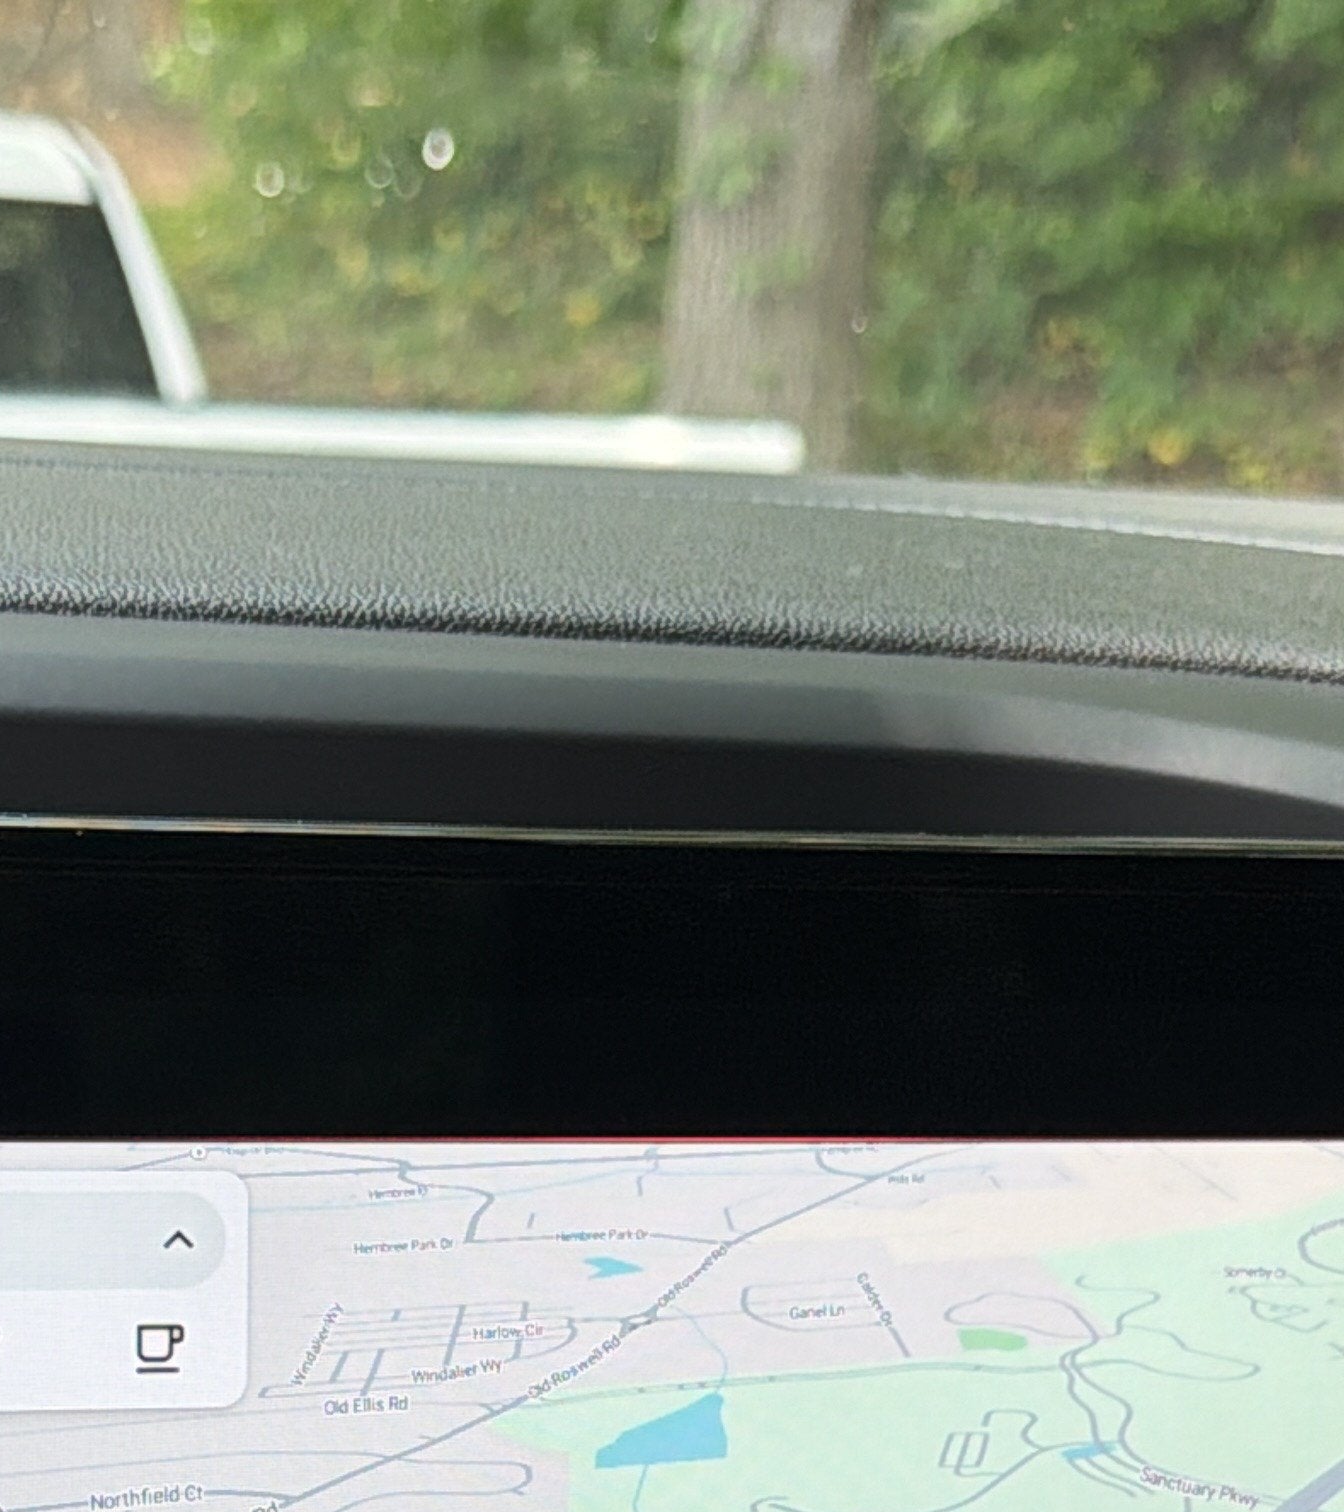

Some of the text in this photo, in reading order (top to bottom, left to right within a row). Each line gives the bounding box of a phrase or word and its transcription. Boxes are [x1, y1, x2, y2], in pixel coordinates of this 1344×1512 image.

[353, 1242, 408, 1254] Hembree
[411, 1239, 437, 1251] Park
[472, 1326, 522, 1340] Harlow
[551, 1347, 603, 1383] Roswell
[601, 1334, 622, 1353] Rd
[323, 1395, 409, 1416] Old Ellis Rd
[89, 1484, 204, 1512] Northfield Ct
[1140, 1465, 1261, 1511] Sanctuary Pkwy
